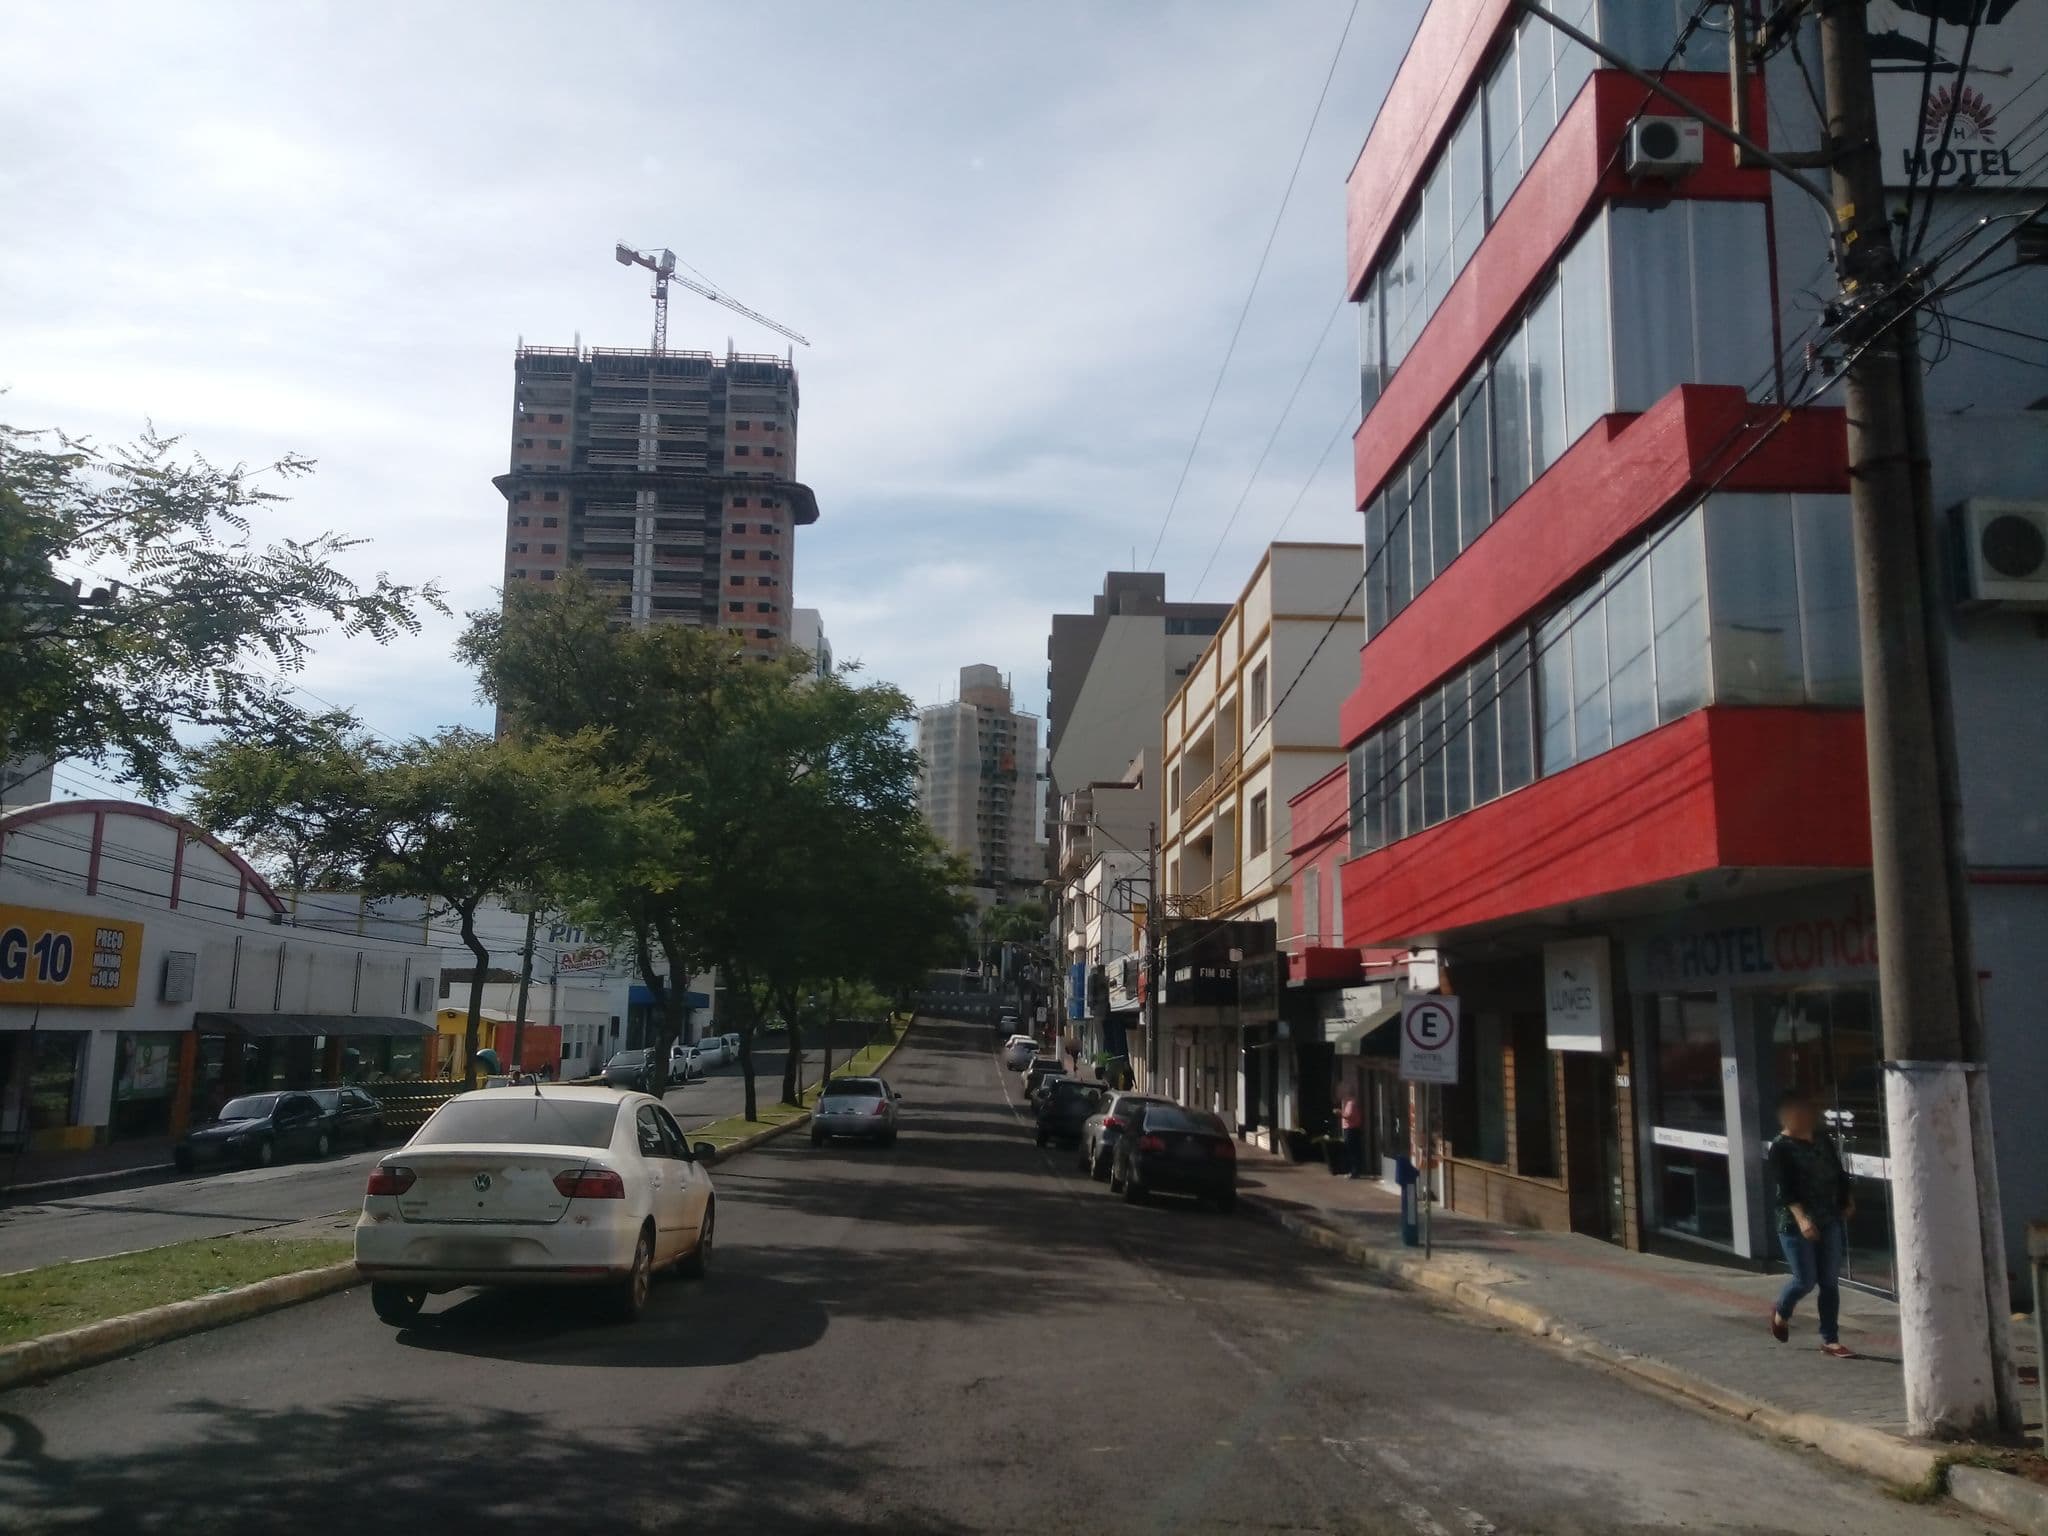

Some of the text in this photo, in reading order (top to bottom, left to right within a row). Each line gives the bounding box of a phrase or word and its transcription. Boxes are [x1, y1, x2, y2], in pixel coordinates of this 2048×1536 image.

[1903, 148, 2021, 176] HOTEL
[95, 928, 124, 952] PREÇO
[1682, 925, 1773, 976] HOTEL
[33, 931, 73, 984] 10
[1199, 967, 1216, 978] FIM
[1219, 968, 1232, 978] DE
[1422, 1012, 1437, 1037] E
